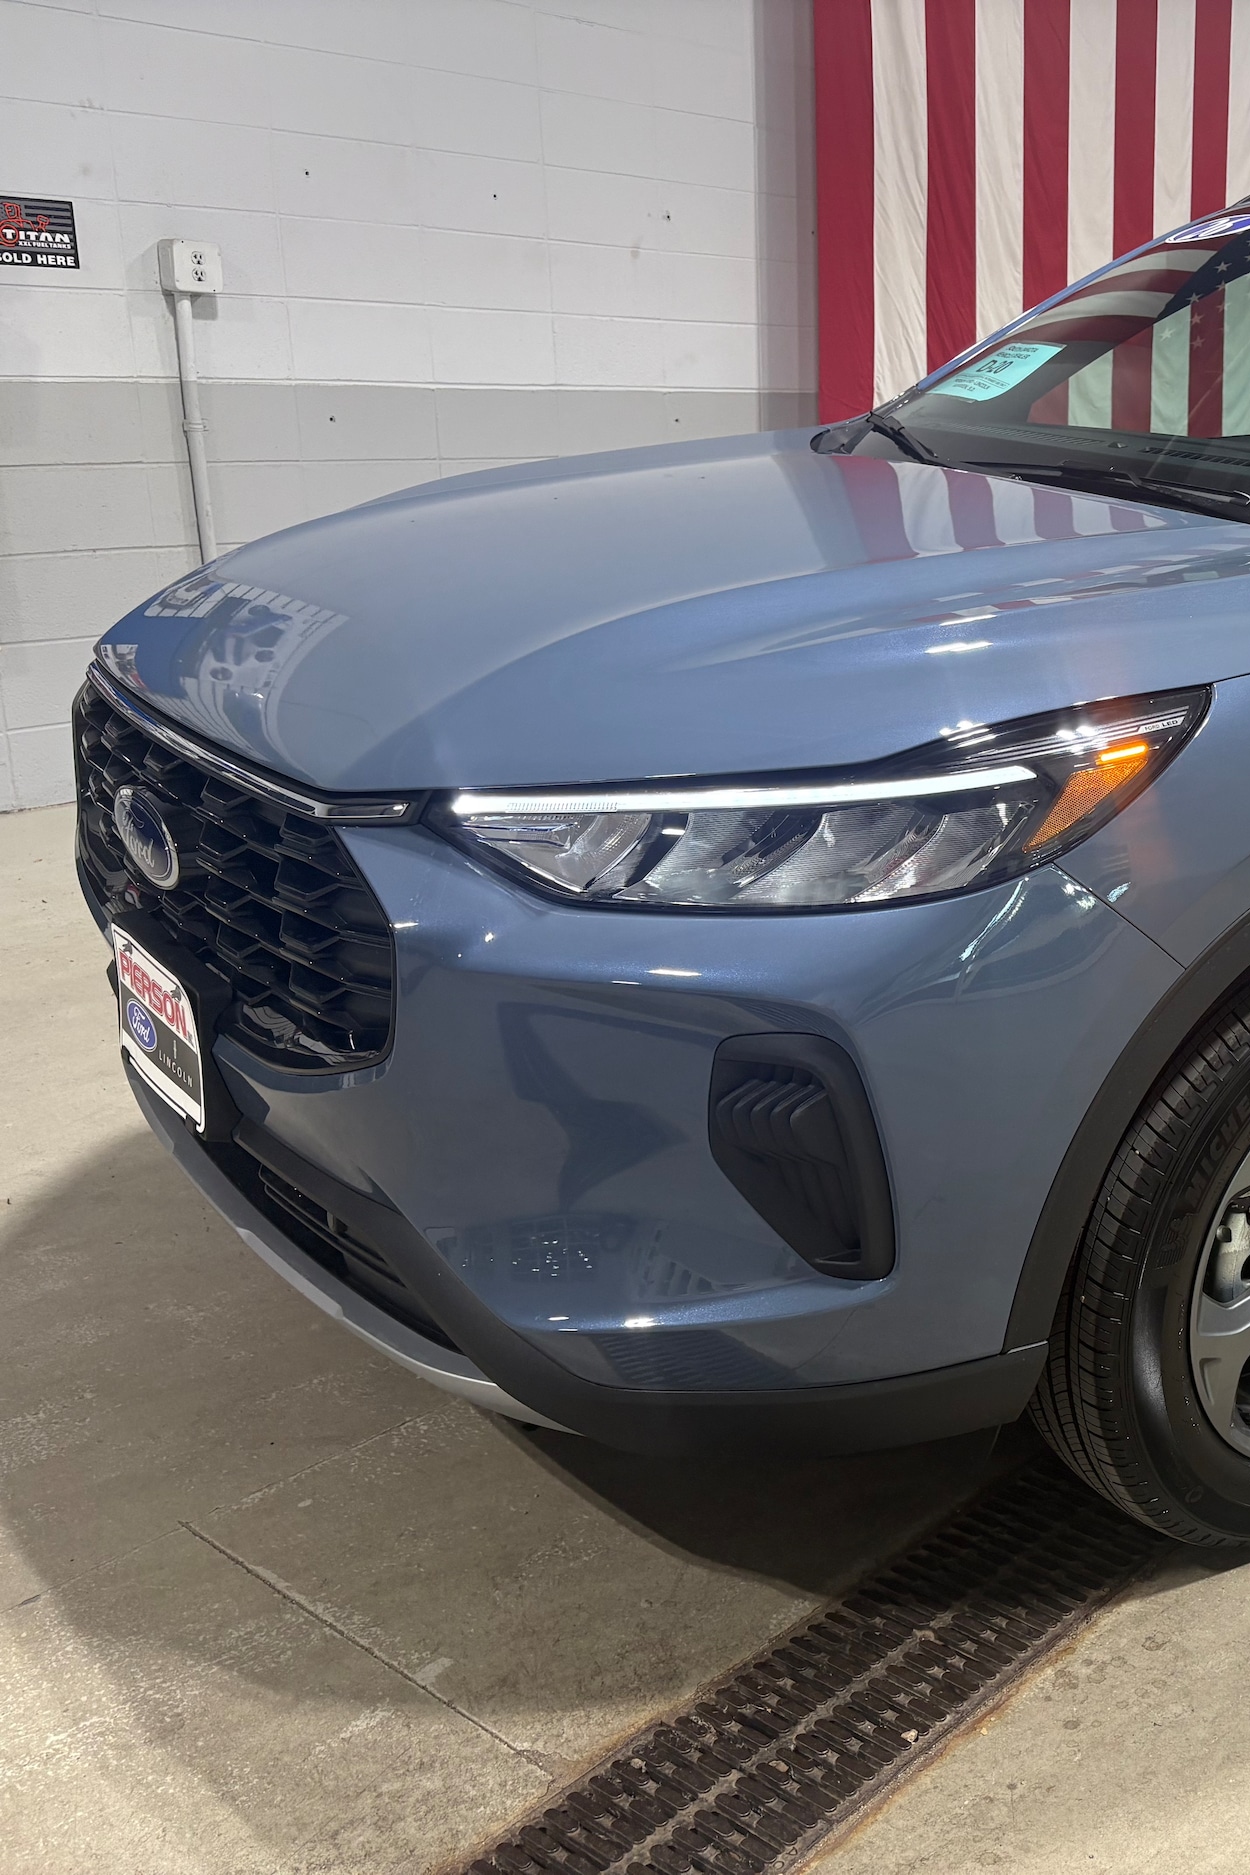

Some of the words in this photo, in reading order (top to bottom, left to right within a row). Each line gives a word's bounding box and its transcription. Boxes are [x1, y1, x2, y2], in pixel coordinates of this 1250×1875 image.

[2, 228, 71, 243] TITAN
[36, 254, 76, 266] HERE
[1161, 719, 1178, 727] LED
[118, 950, 189, 1039] PIERSON
[158, 1049, 193, 1088] LINCOLN
